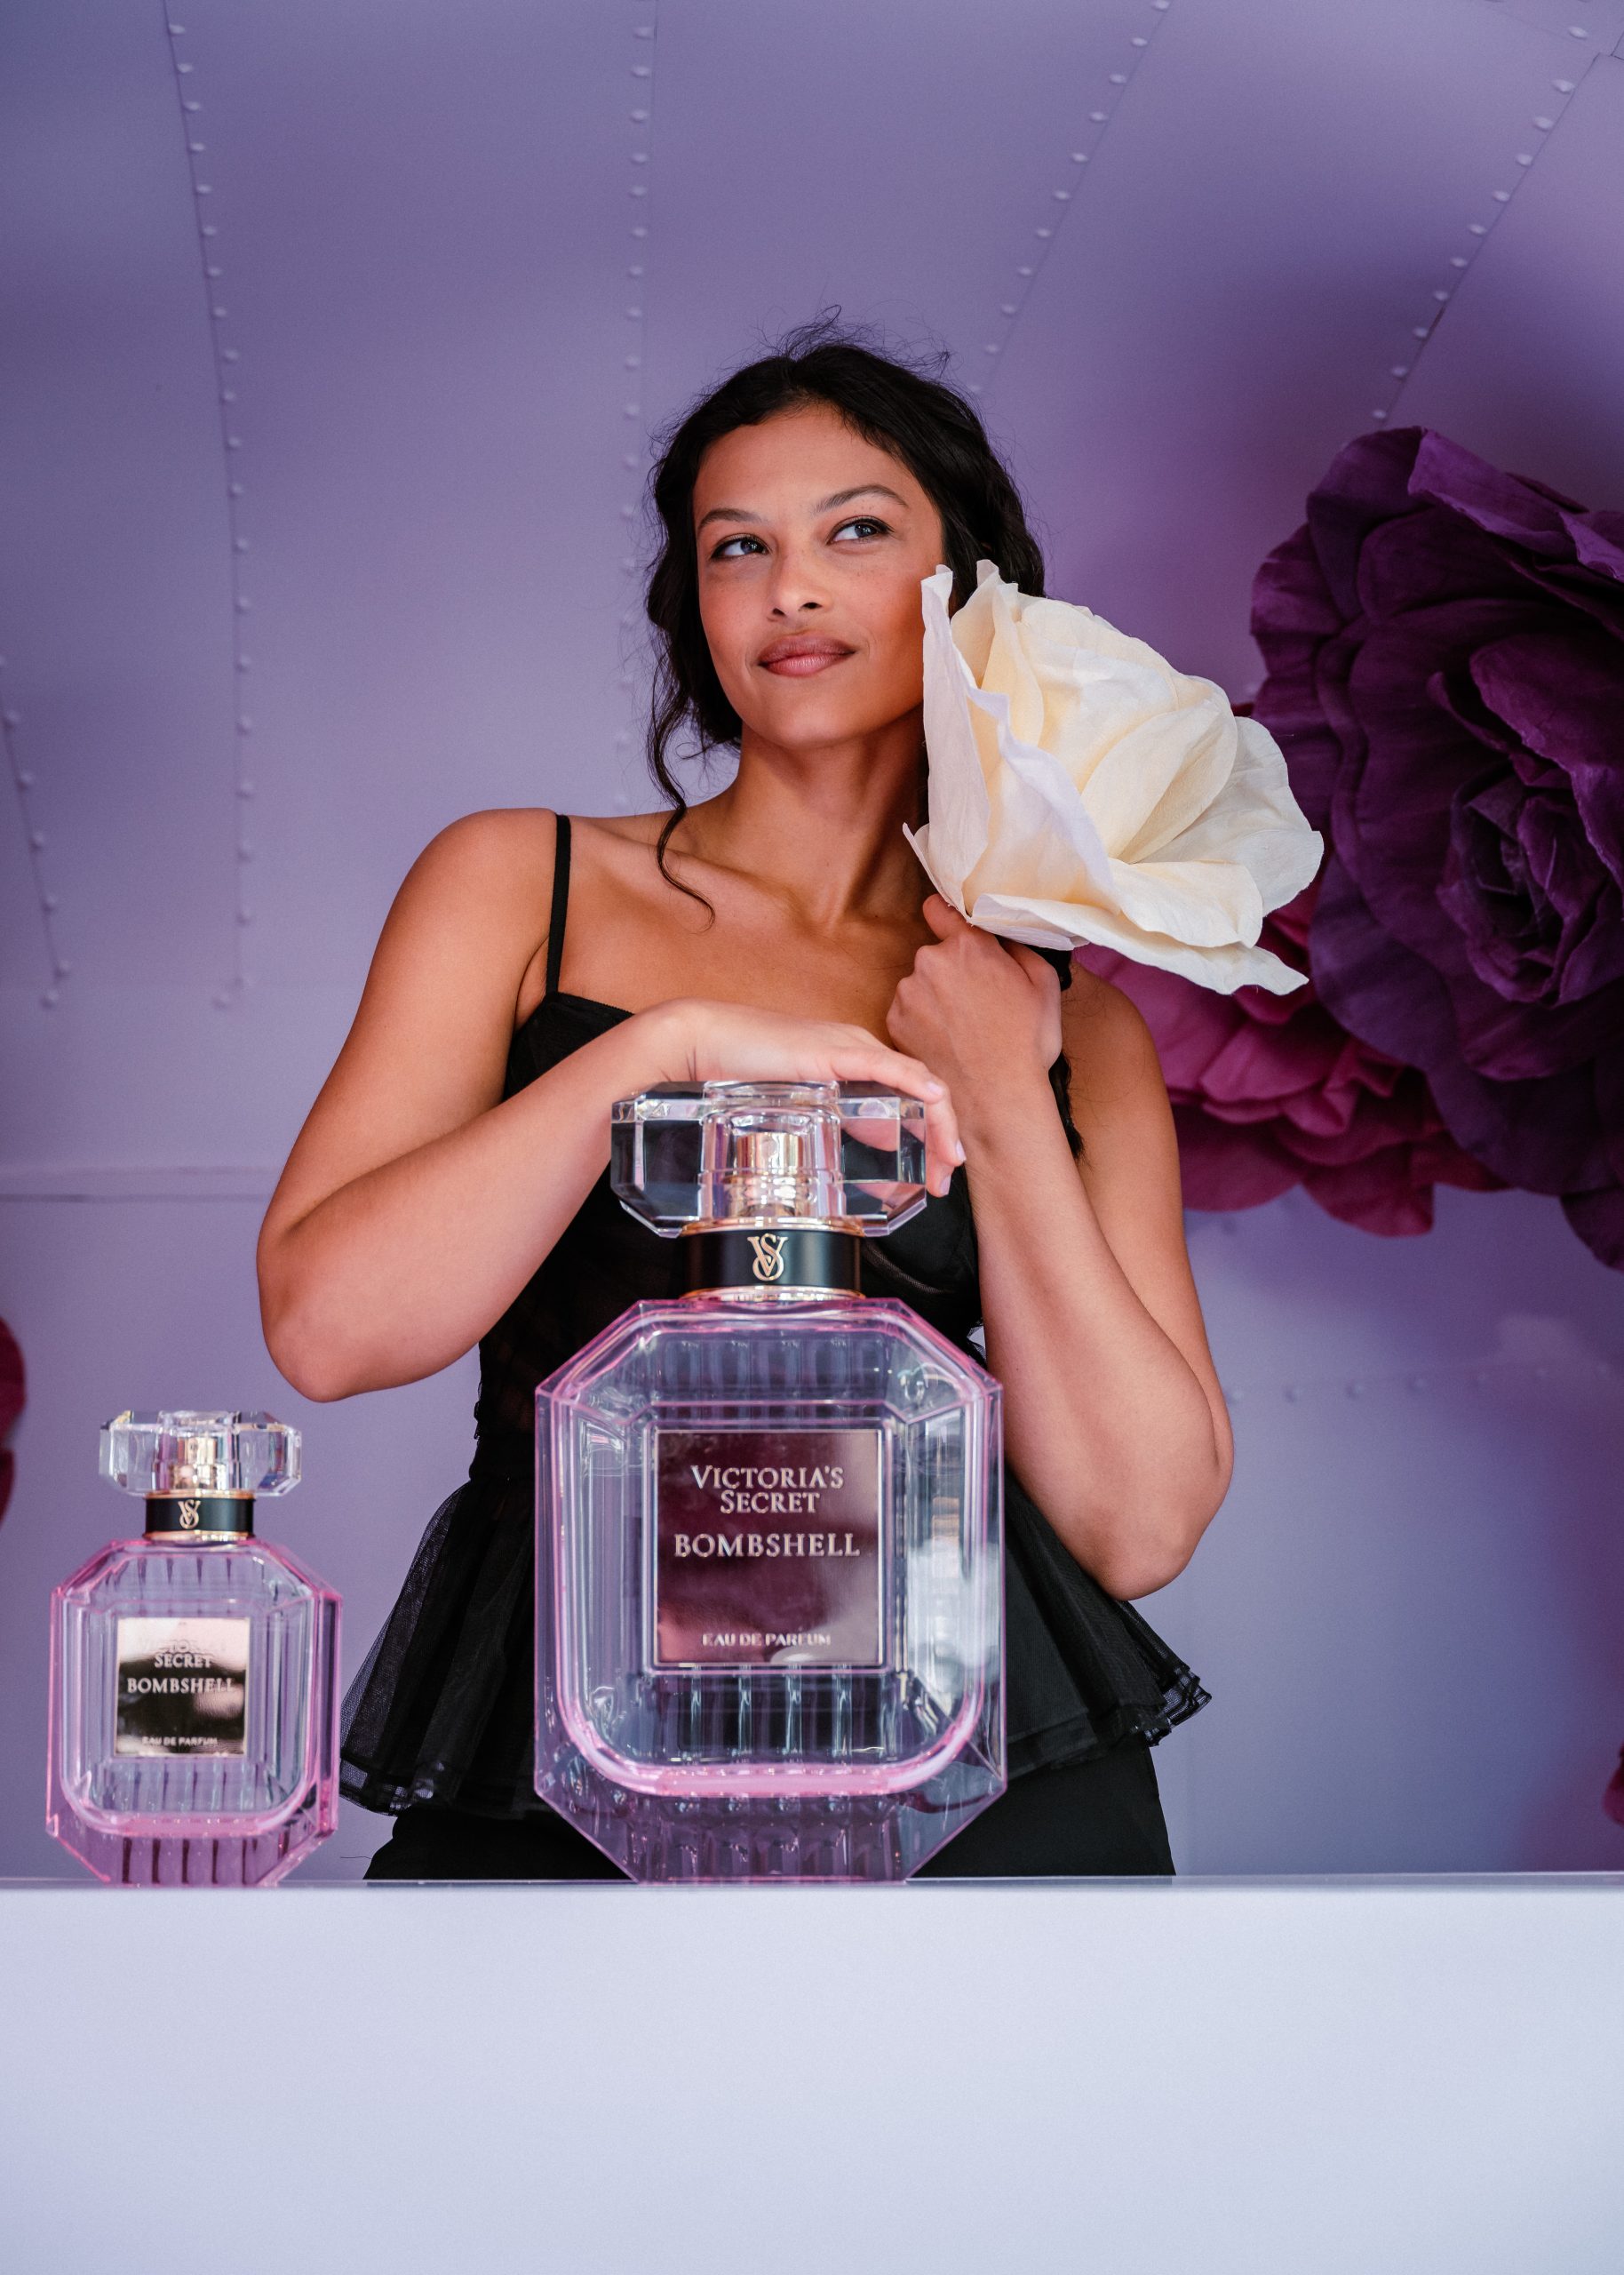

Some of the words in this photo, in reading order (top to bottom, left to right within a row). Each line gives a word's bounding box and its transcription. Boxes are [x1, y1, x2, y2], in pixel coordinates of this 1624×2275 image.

[690, 1465, 844, 1489] VICTORIA'S
[720, 1489, 820, 1513] SECRET
[673, 1533, 861, 1557] BOMBSHELL
[702, 1633, 736, 1646] EAU
[739, 1633, 761, 1646] DE
[765, 1633, 831, 1646] PARFUM
[154, 1653, 213, 1668] SECRET
[126, 1678, 234, 1693] BOMBSHELL
